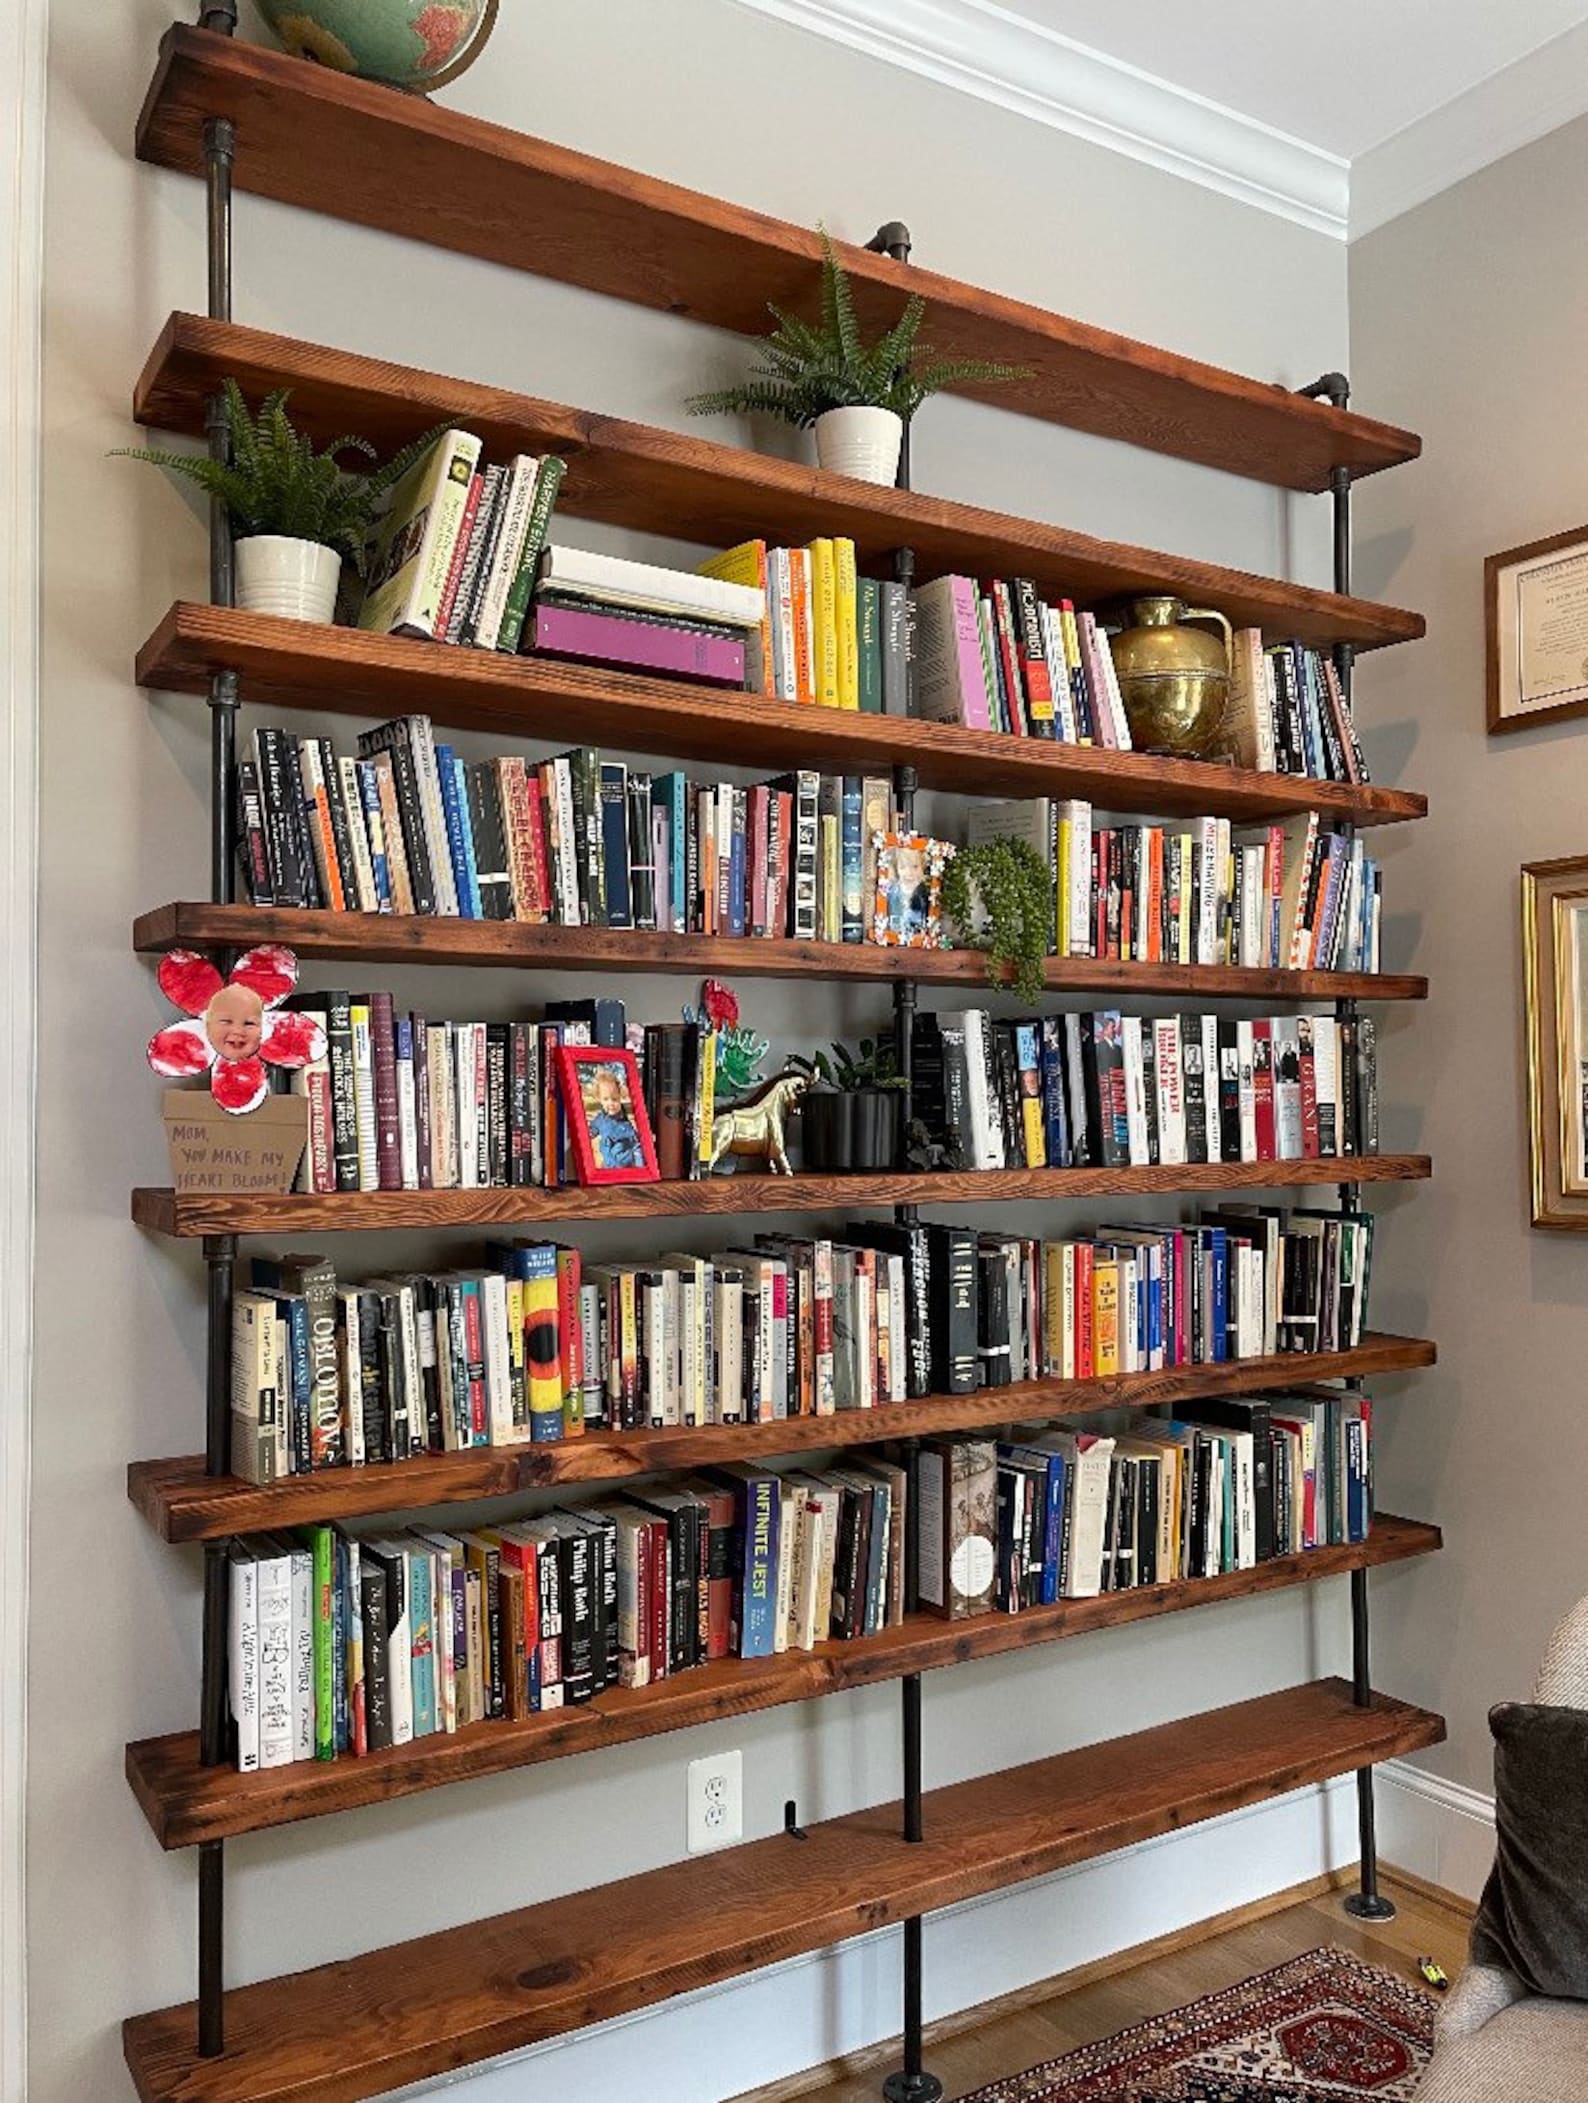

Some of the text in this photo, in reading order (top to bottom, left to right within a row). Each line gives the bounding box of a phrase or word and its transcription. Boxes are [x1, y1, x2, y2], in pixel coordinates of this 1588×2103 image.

[1303, 1063, 1317, 1134] GRANT
[172, 1126, 209, 1142] MOM,
[181, 1149, 284, 1167] YOU MAKE MY
[177, 1173, 223, 1188] HEART
[752, 1482, 771, 1599] INFINITE JEST
[571, 1539, 588, 1585] Philip
